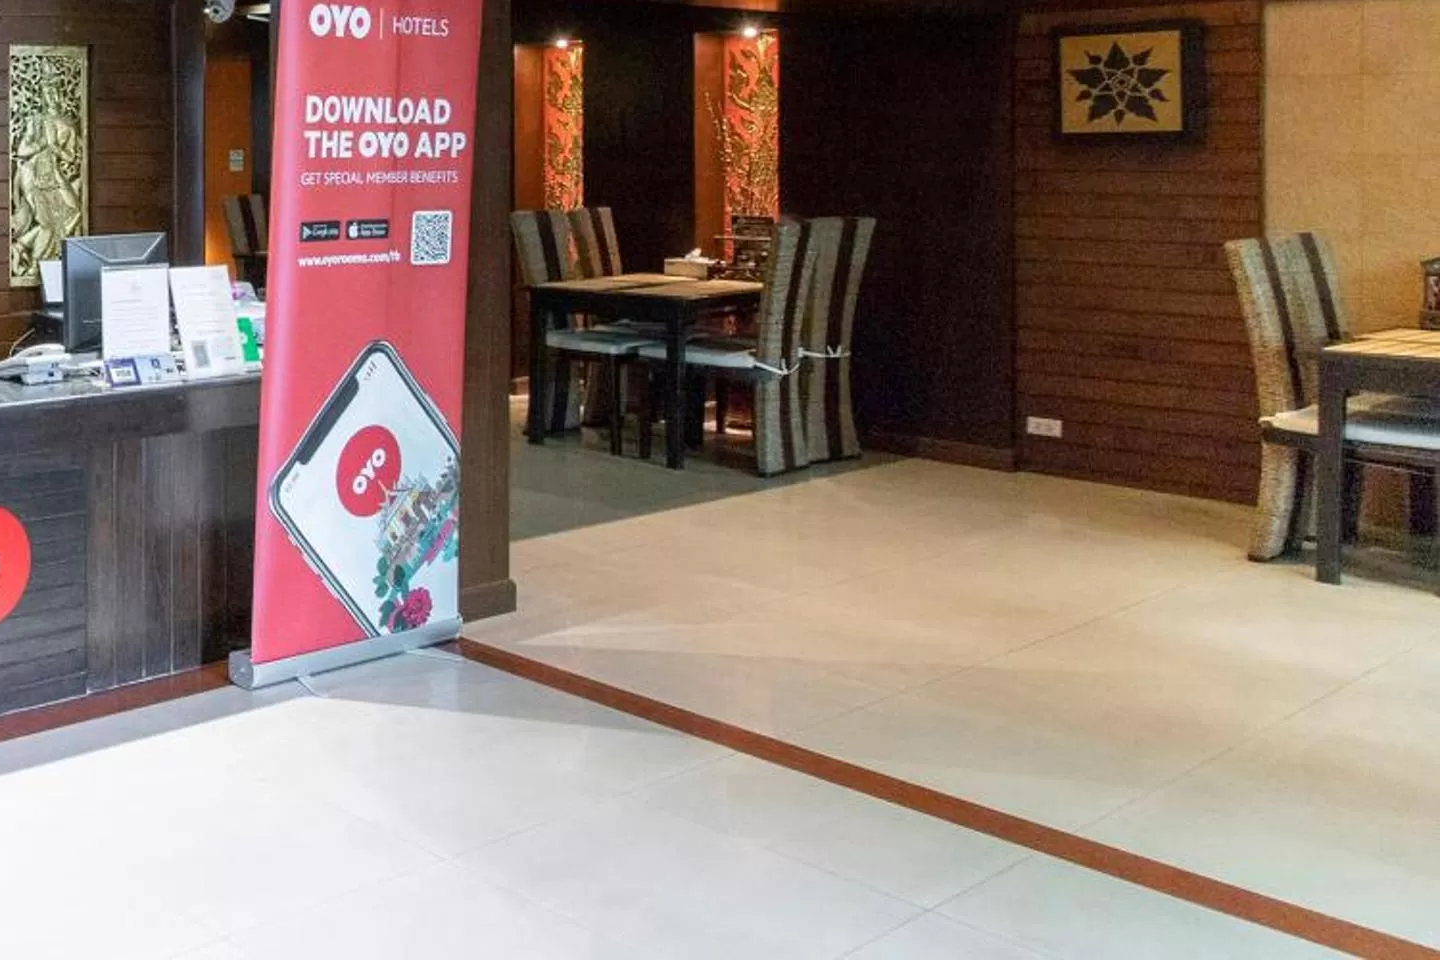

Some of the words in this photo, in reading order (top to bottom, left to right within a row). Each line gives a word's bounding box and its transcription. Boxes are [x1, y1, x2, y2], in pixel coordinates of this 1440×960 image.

[308, 2, 372, 39] OYO
[392, 16, 449, 38] HOTELS
[305, 95, 451, 125] DOWNLOAD
[304, 130, 352, 158] THE
[358, 131, 409, 158] OYO
[415, 132, 467, 159] APP
[300, 172, 321, 186] GET
[324, 171, 363, 185] SPECIAL
[366, 171, 409, 184] MEMBER
[410, 170, 459, 184] BENEFITS
[352, 447, 387, 495] OYO
